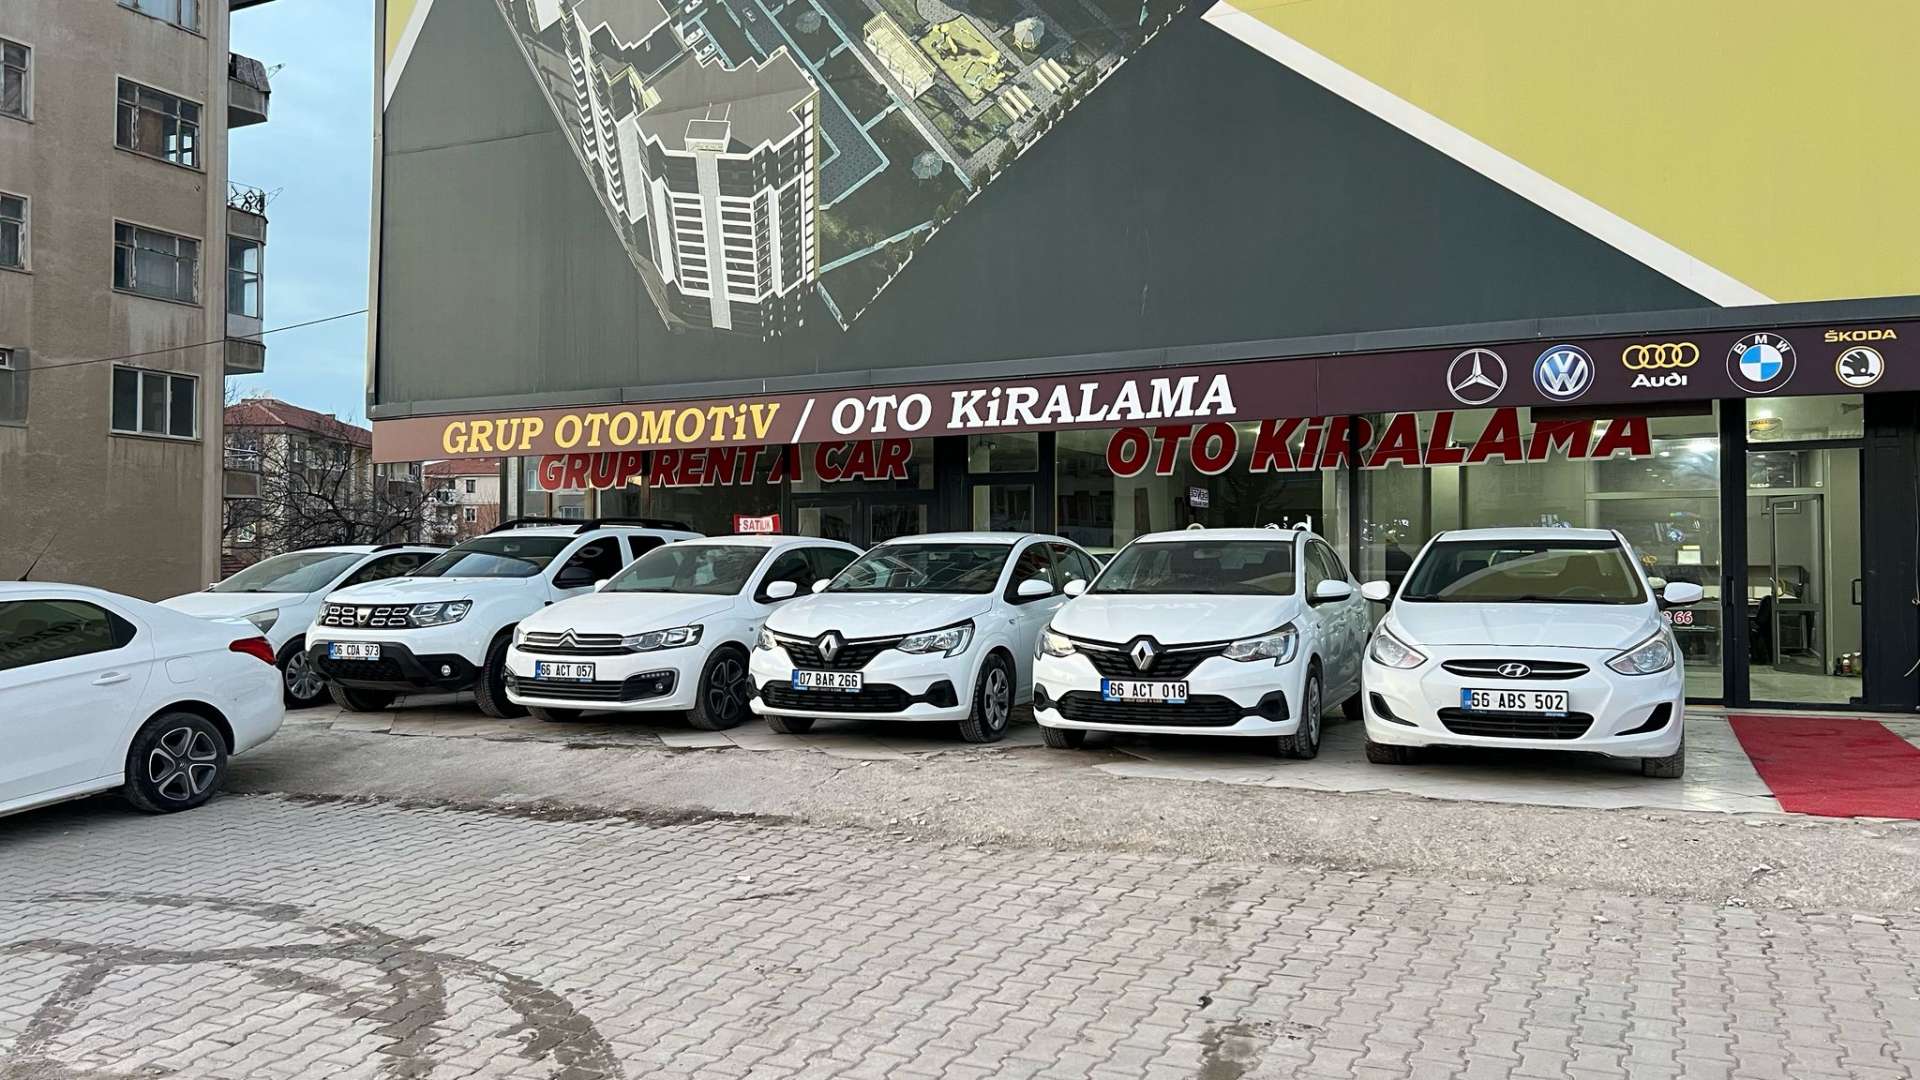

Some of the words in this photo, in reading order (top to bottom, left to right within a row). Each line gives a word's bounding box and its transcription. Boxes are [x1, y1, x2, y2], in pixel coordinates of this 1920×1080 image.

[1734, 334, 1790, 355] BMW
[1824, 329, 1897, 343] ŠKODA
[1630, 372, 1688, 389] Audi
[442, 416, 544, 454] GRUP
[831, 393, 932, 435] OTO
[1106, 421, 1240, 479] OTO
[538, 452, 643, 493] GRUP
[649, 446, 769, 489] RENT
[815, 438, 913, 484] CAR
[365, 645, 379, 656] 973
[556, 664, 571, 677] ACT
[576, 665, 593, 678] 057
[800, 672, 812, 685] 07
[815, 673, 834, 686] BAR
[838, 674, 858, 688] 266
[1110, 682, 1125, 697] 66
[1132, 683, 1154, 698] ACT
[1162, 684, 1186, 698] 018
[1471, 692, 1490, 708] 66
[1498, 693, 1526, 709] ABS
[1534, 694, 1564, 711] 502
